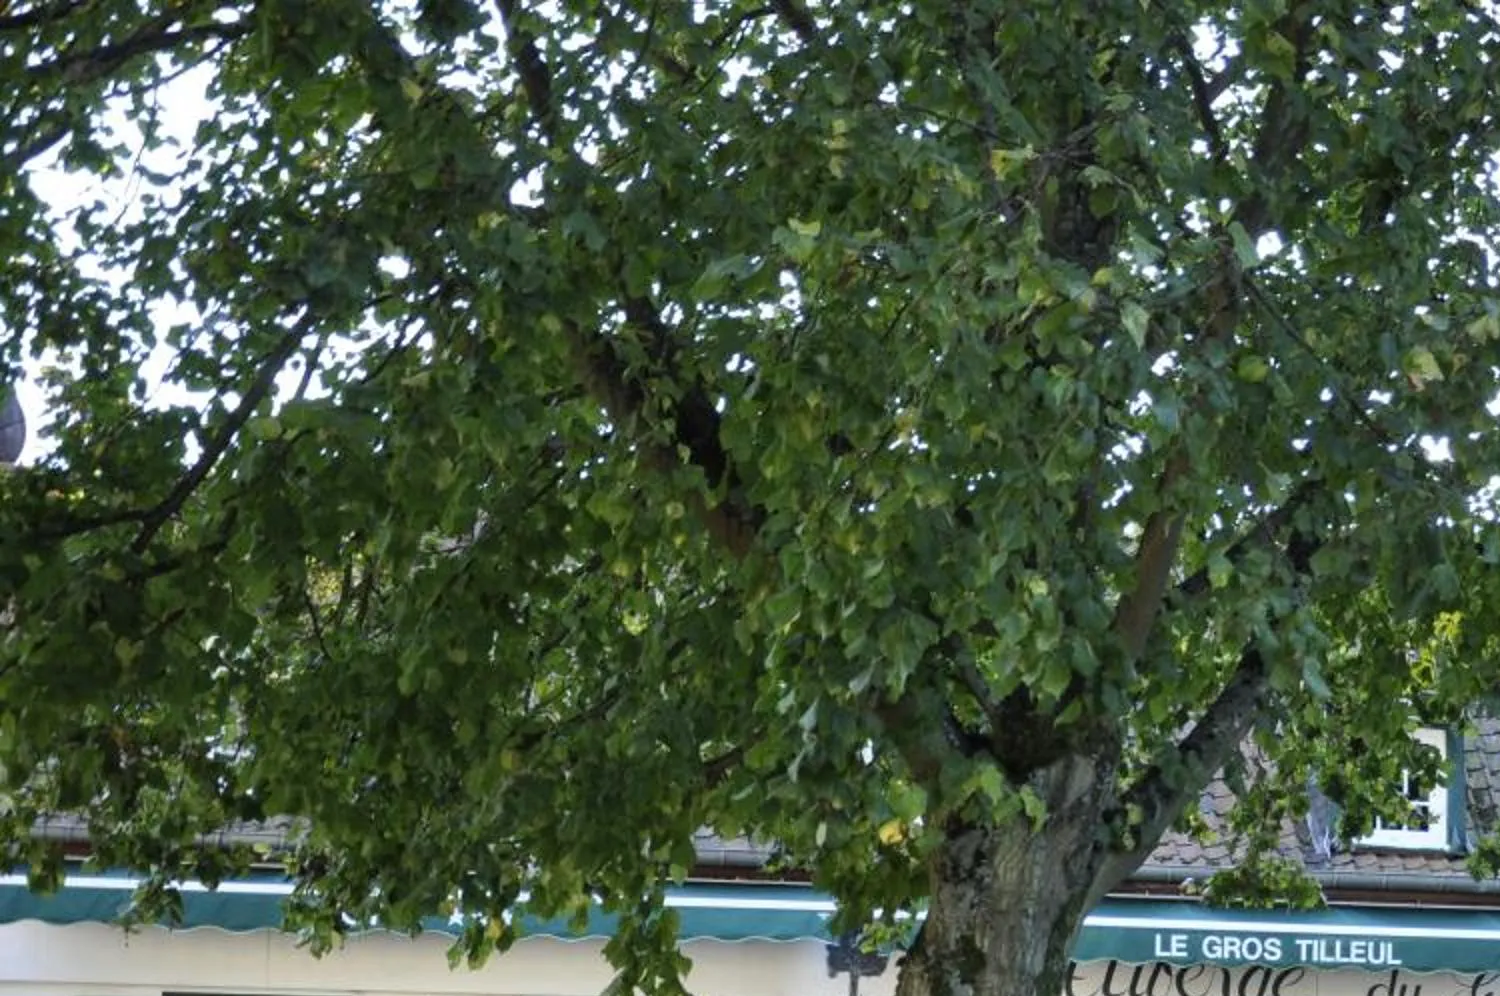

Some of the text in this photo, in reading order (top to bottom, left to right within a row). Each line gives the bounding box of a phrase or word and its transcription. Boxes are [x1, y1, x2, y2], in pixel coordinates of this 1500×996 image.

[1154, 933, 1402, 965] LE GROS TILLEUL
